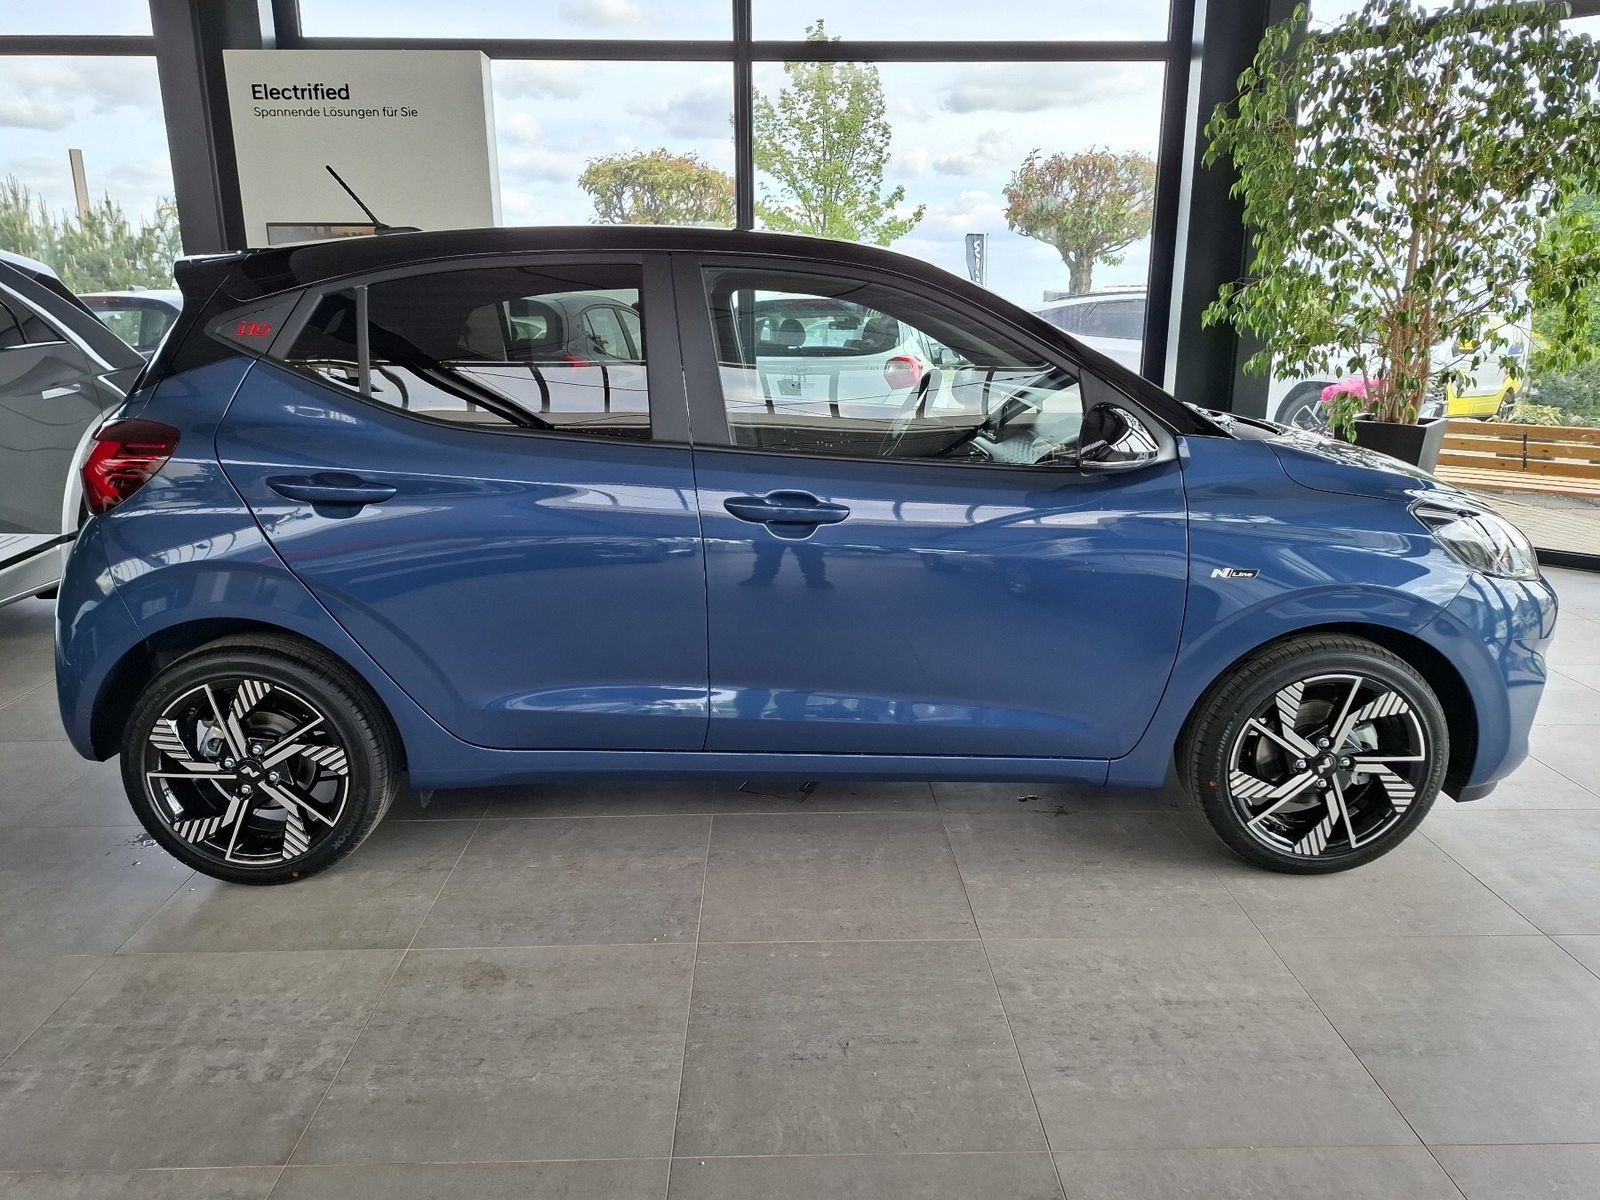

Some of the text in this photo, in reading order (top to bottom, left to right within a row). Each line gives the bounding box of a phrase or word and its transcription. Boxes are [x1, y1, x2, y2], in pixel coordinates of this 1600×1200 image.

[251, 83, 350, 100] Electrified
[253, 106, 418, 119] Spannende Lösungen für Sie
[1210, 567, 1231, 578] N
